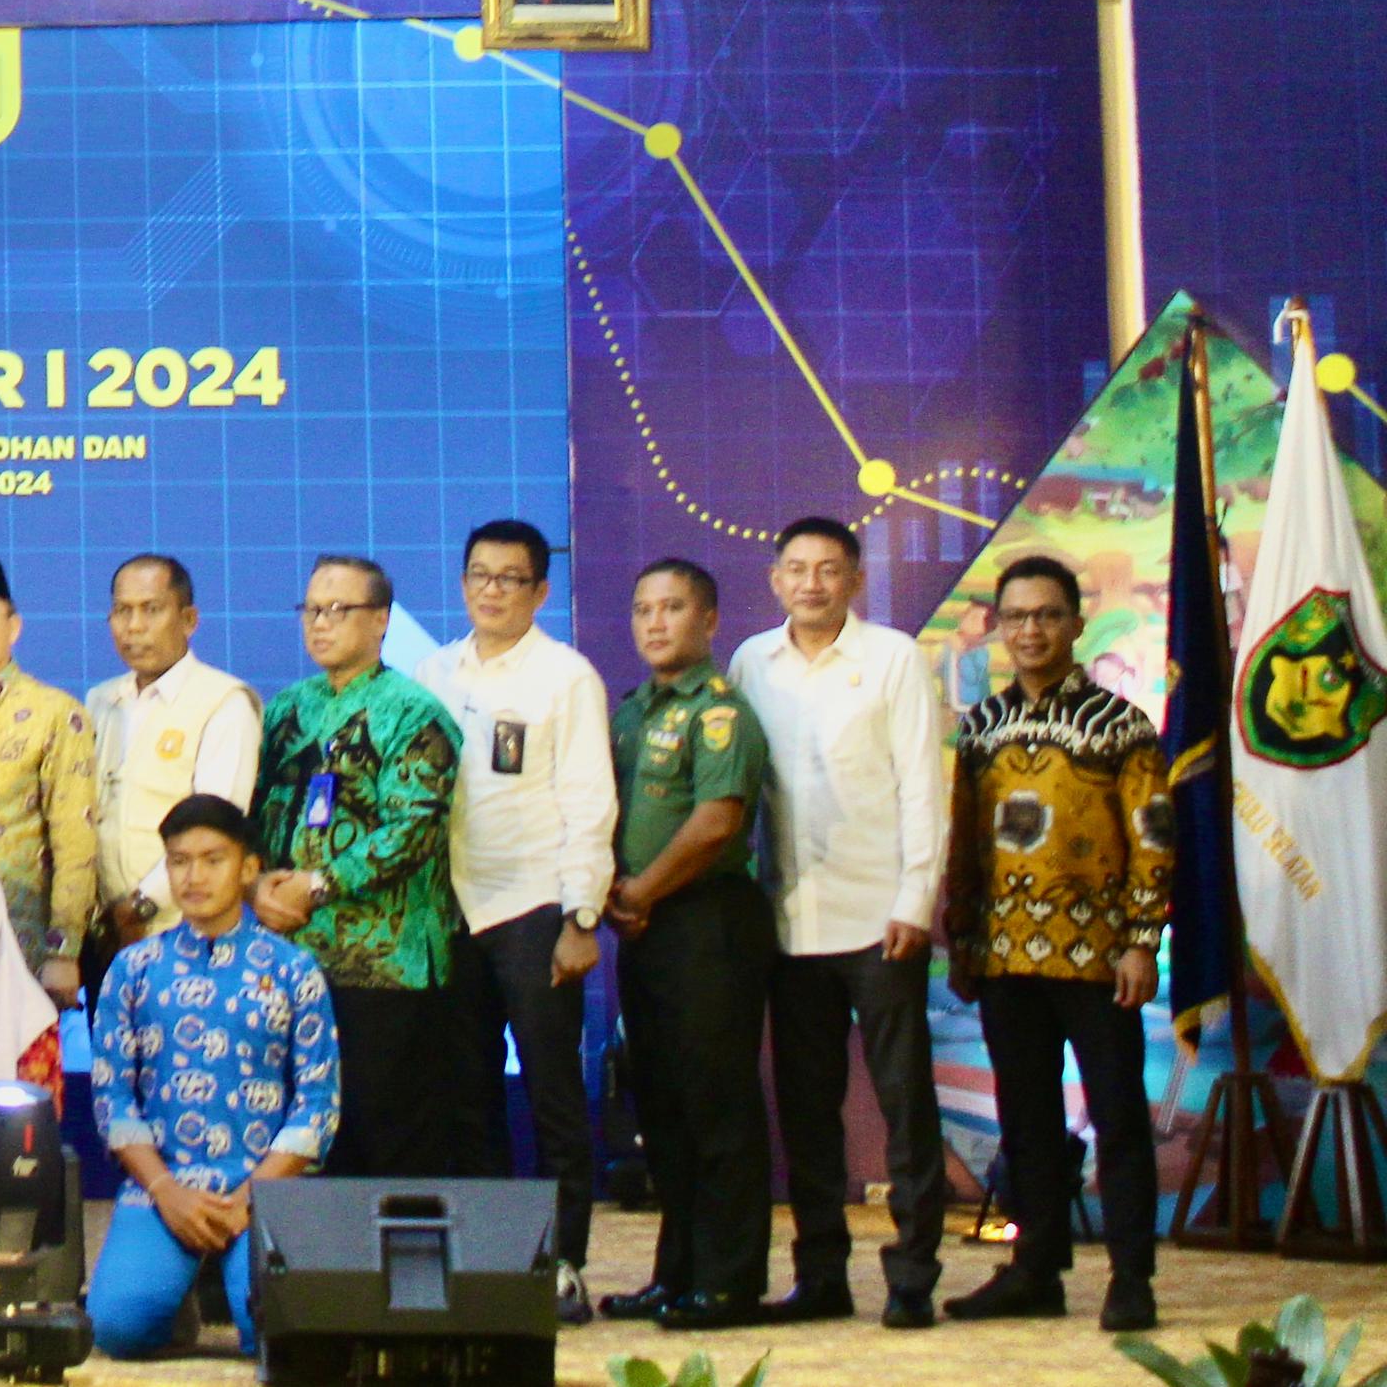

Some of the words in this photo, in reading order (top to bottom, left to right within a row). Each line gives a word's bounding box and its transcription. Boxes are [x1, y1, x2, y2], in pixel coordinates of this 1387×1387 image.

[46, 349, 65, 408] I
[87, 346, 287, 409] 2024
[83, 435, 147, 461] DAN
